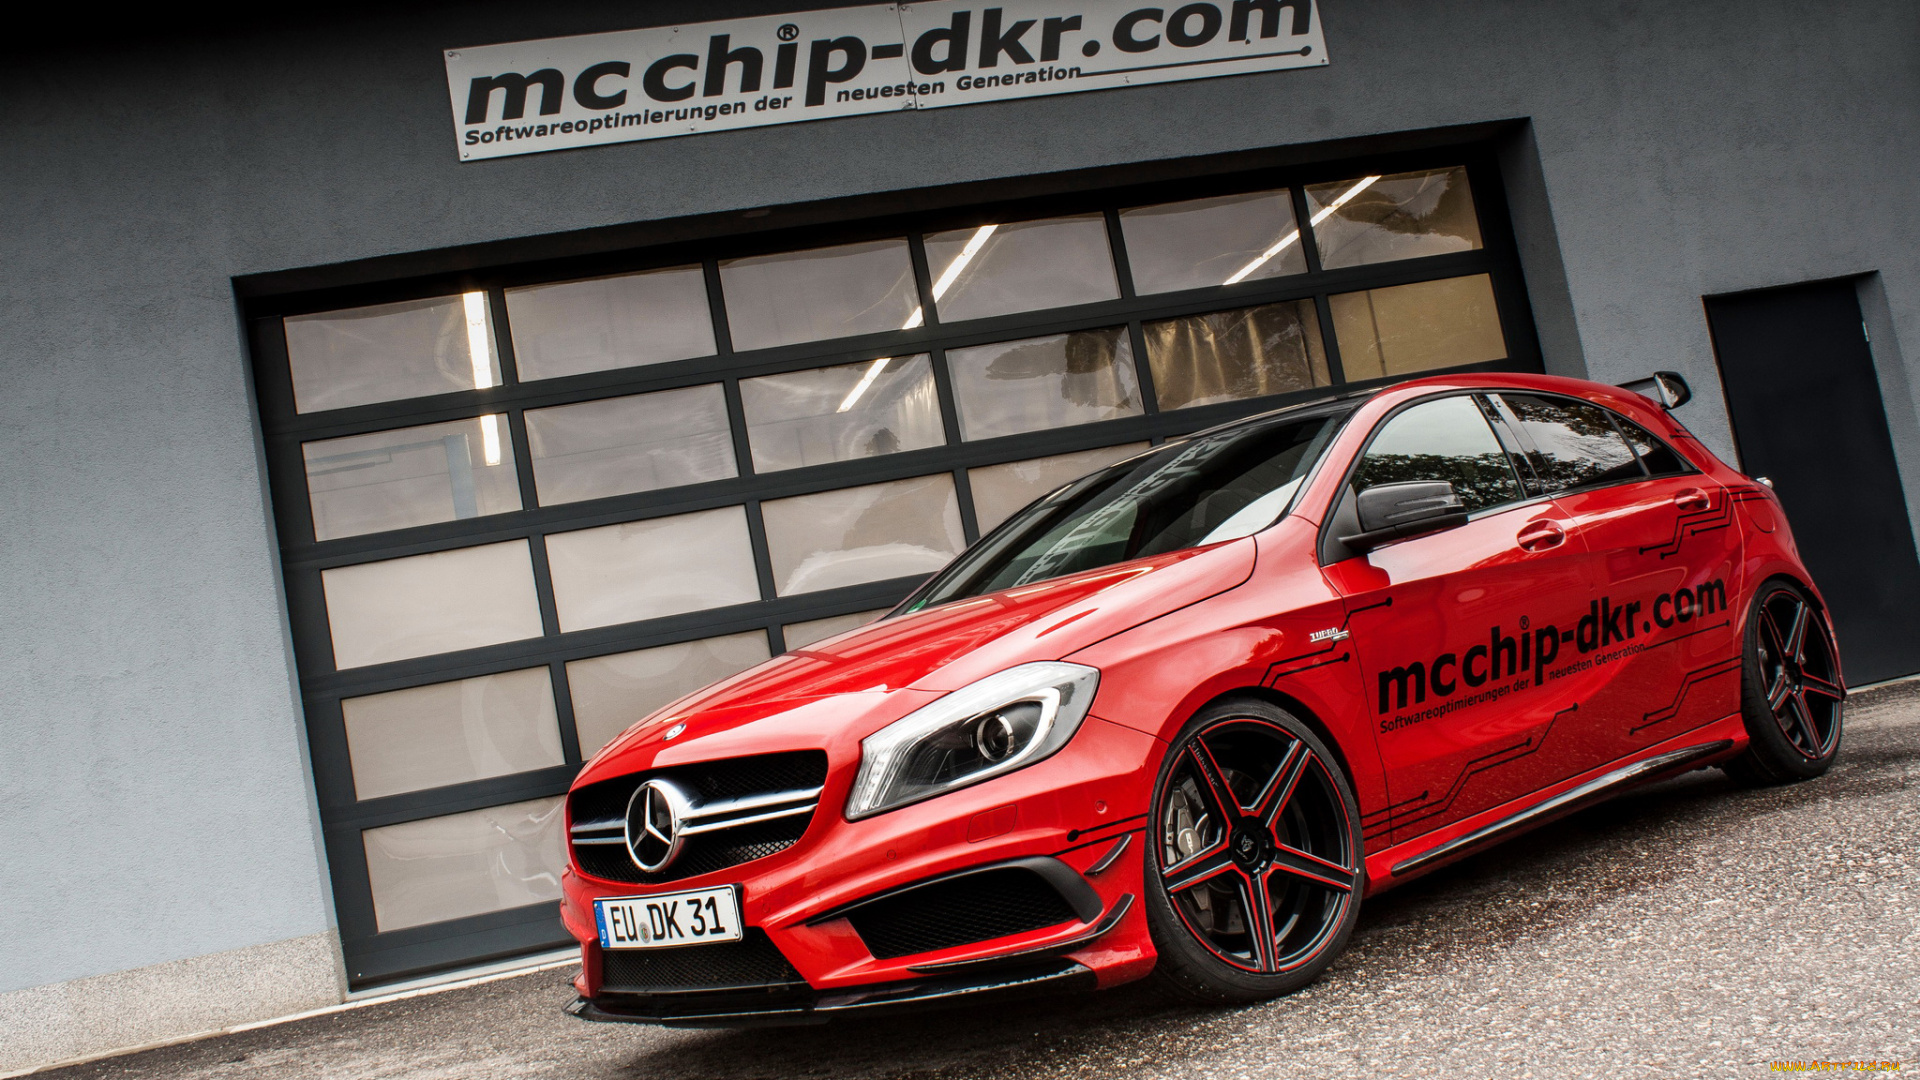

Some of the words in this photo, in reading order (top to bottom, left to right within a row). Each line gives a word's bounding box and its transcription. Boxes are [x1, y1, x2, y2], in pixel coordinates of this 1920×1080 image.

[465, 102, 746, 146] Softwareoptimierungen
[754, 95, 793, 113] der
[837, 80, 945, 102] neuesten
[956, 65, 1082, 91] Generation
[1380, 684, 1511, 734] Softwareoptimierungen
[1513, 676, 1530, 694] der
[1549, 659, 1593, 681] neuesten
[1595, 641, 1646, 667] Generation
[610, 905, 638, 942] EU
[646, 900, 685, 940] DK
[687, 896, 726, 936] 31
